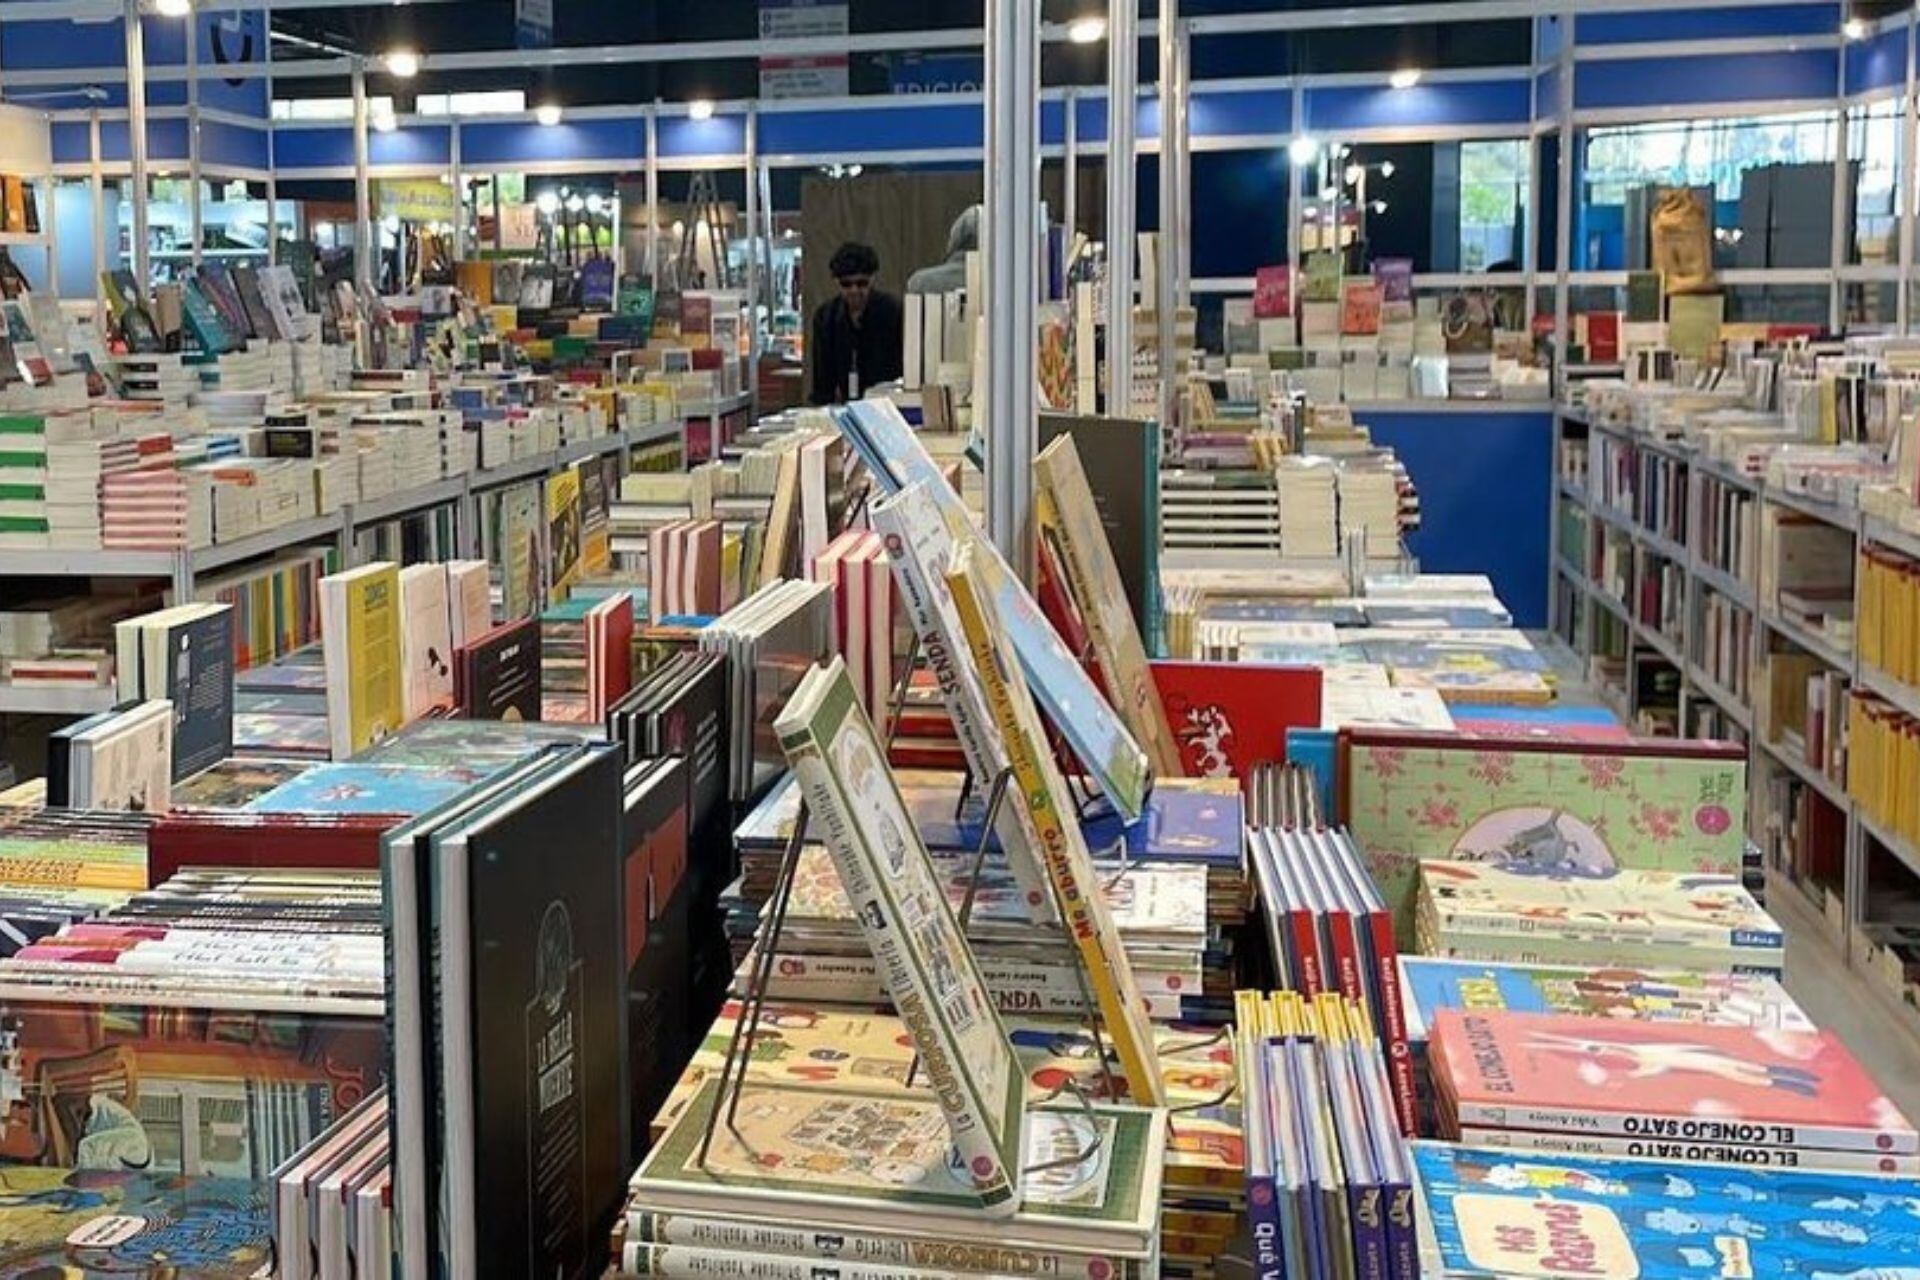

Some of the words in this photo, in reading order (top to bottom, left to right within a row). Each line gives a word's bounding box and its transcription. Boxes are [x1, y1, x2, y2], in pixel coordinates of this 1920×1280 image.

[1043, 828, 1081, 901] aburro
[900, 992, 966, 1112] CURIOSA
[957, 1112, 977, 1135] La
[1624, 1117, 1677, 1135] SATO
[1682, 1120, 1766, 1142] CONEJO
[1770, 1126, 1795, 1144] EL
[1628, 1142, 1682, 1159] SATO
[1687, 1147, 1771, 1165] CONEJO
[1774, 1150, 1799, 1167] EL
[1253, 1221, 1278, 1264] Qué
[914, 1241, 1039, 1274] CURIOSA
[1042, 1256, 1059, 1275] La
